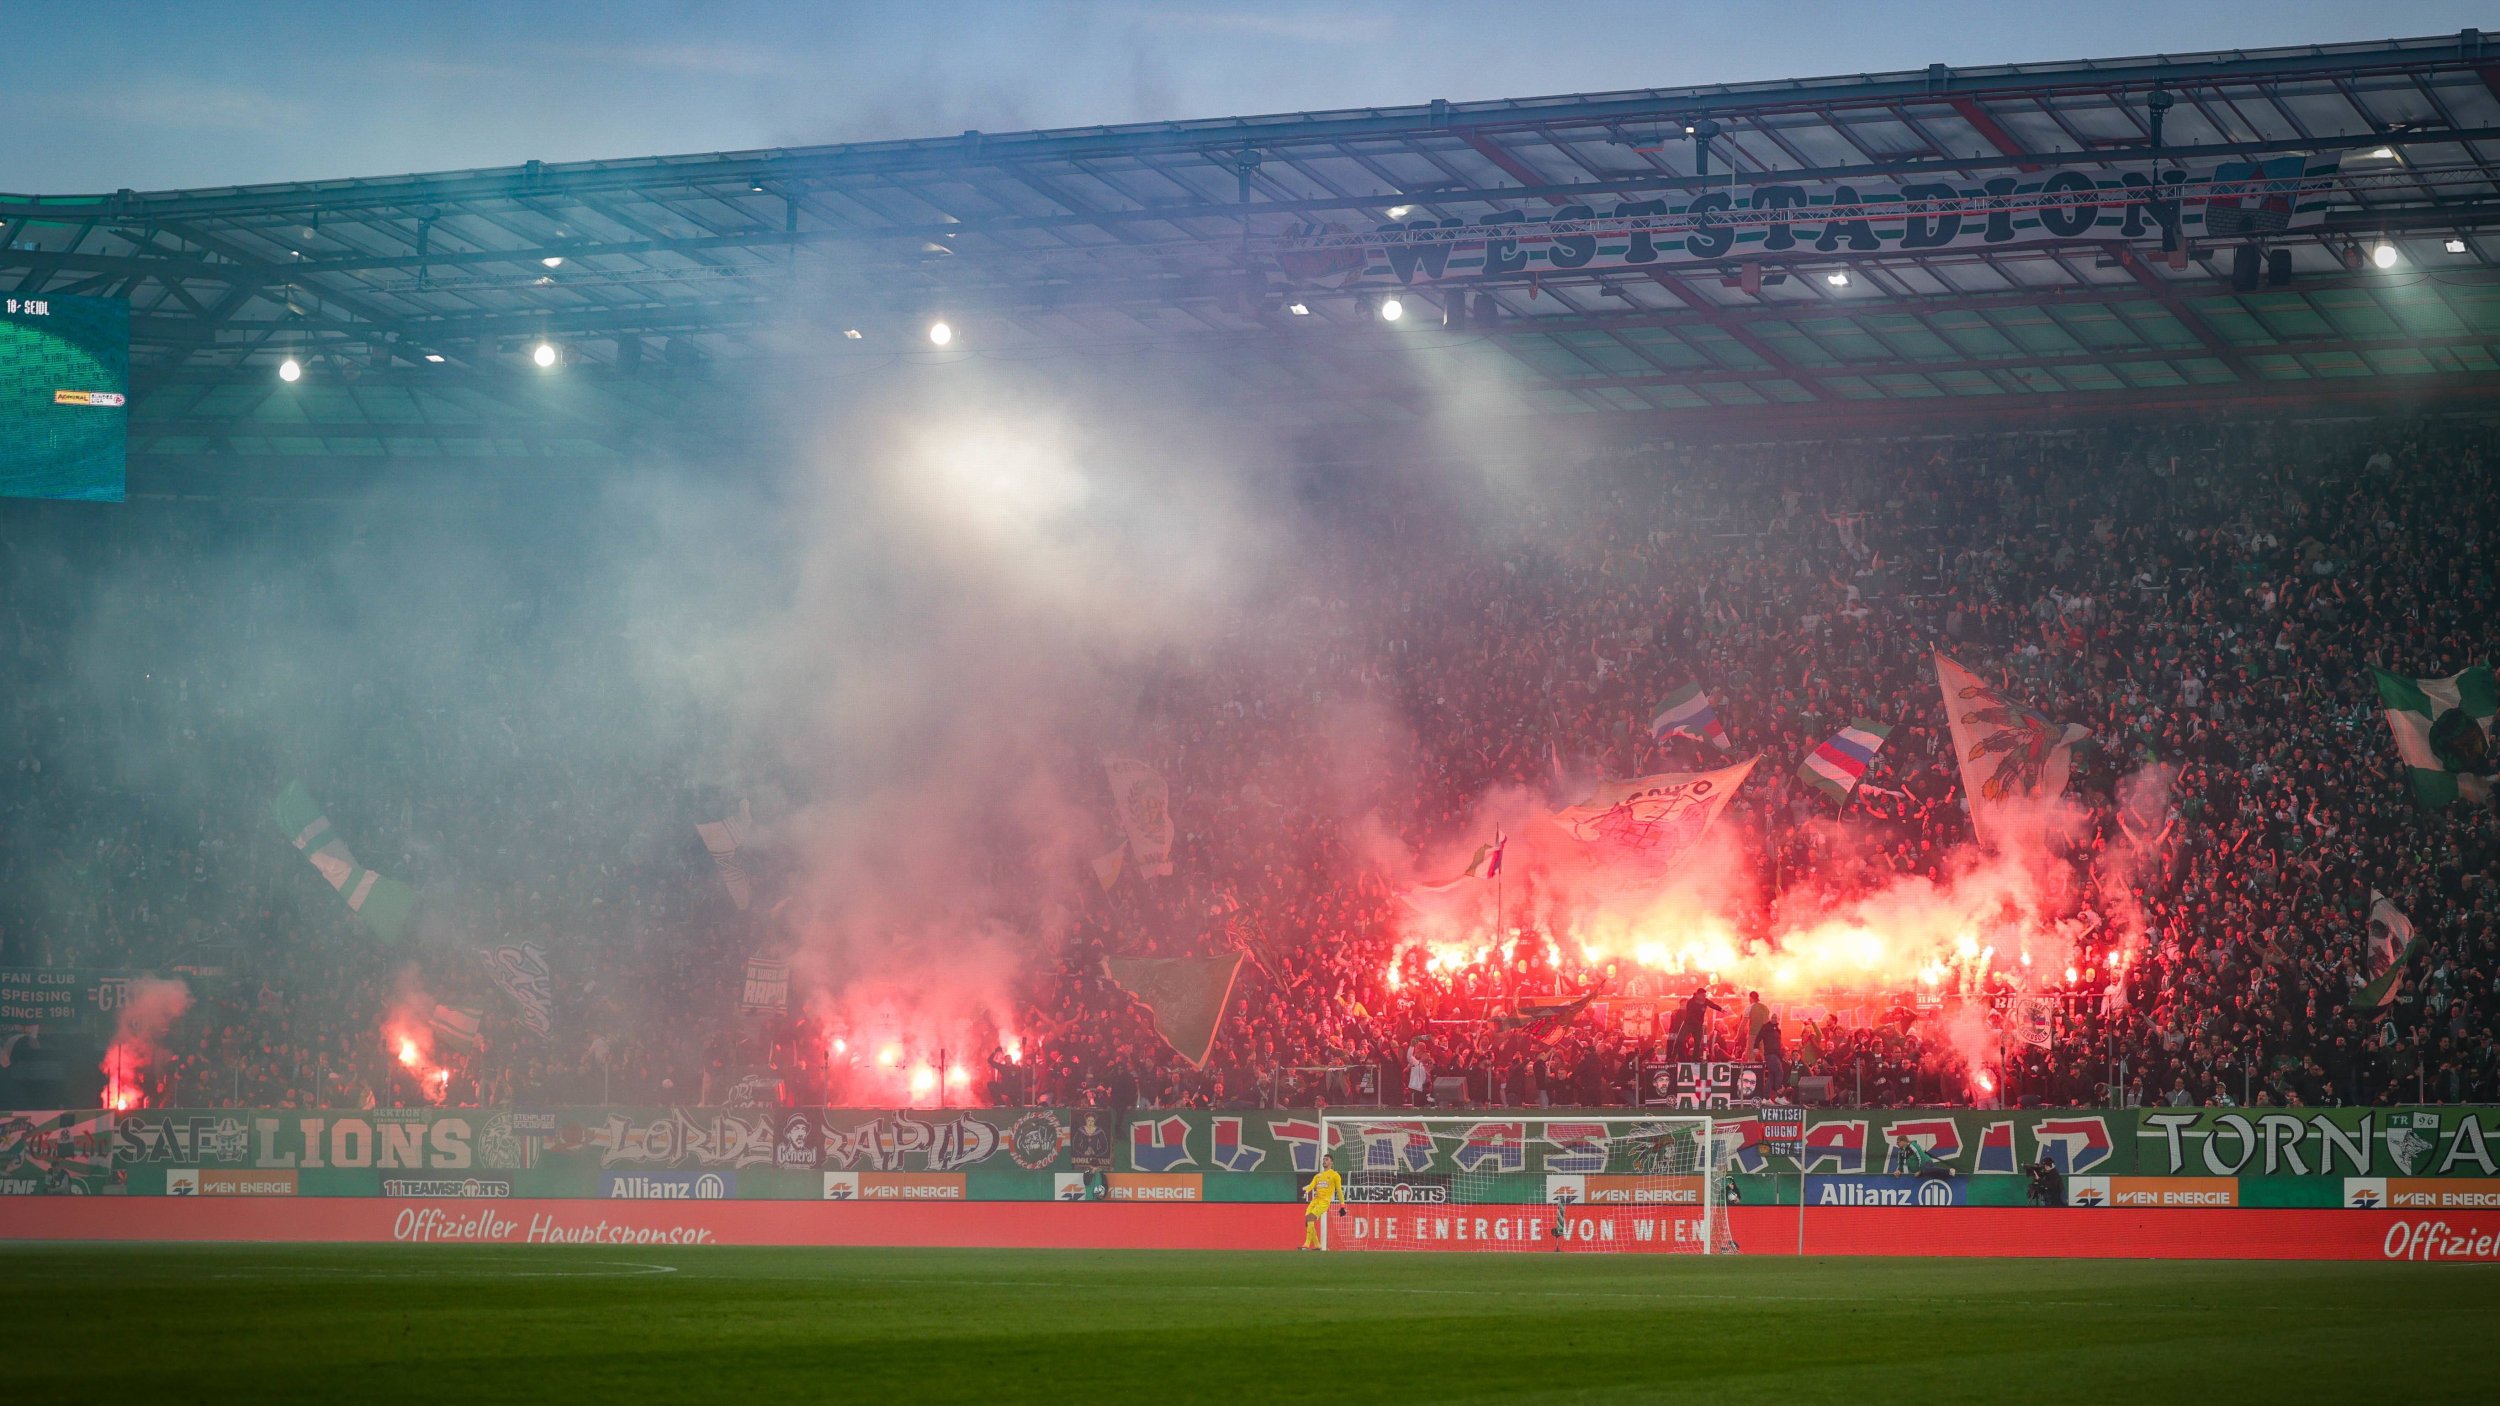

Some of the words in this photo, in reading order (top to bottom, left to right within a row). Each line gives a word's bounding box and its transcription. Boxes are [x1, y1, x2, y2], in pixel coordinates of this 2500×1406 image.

[1376, 170, 2188, 284] WESTSTADION
[24, 300, 50, 316] SEIDL
[1, 973, 31, 984] FAN
[38, 974, 75, 985] CLUB
[1, 989, 71, 1002] SPEISING
[1, 1006, 43, 1018] SINCE
[1761, 1108, 1802, 1121] VENTISEI
[2391, 1116, 2409, 1126] TR
[2418, 1116, 2434, 1127] 96
[601, 1106, 774, 1169] LORDS
[1764, 1126, 1798, 1138] GIUGNO
[255, 1118, 472, 1169] LIONS
[820, 1108, 1000, 1171] RAPID
[1130, 1114, 1612, 1174] ULTRAS
[1693, 1116, 2114, 1175] RAPID
[204, 1182, 238, 1194] WIEN
[240, 1182, 292, 1194] ENERGIE
[611, 1177, 690, 1199] Allianz
[863, 1185, 899, 1197] WIEN
[903, 1185, 959, 1198] ENERGIE
[1137, 1187, 1196, 1199] ENERGIE
[1819, 1183, 1912, 1206] Allianz
[1590, 1189, 1630, 1202] WIEN
[1634, 1189, 1697, 1202] ENERGIE
[2116, 1191, 2158, 1205] WIEN
[2163, 1191, 2231, 1205] ENERGIE
[2393, 1192, 2437, 1206] WIEN
[393, 1206, 518, 1243] Offizieller
[1354, 1216, 1398, 1240] DIE
[1416, 1217, 1543, 1241] ENERGIE
[1562, 1218, 1615, 1242] VON
[1633, 1219, 1707, 1243] WIEN
